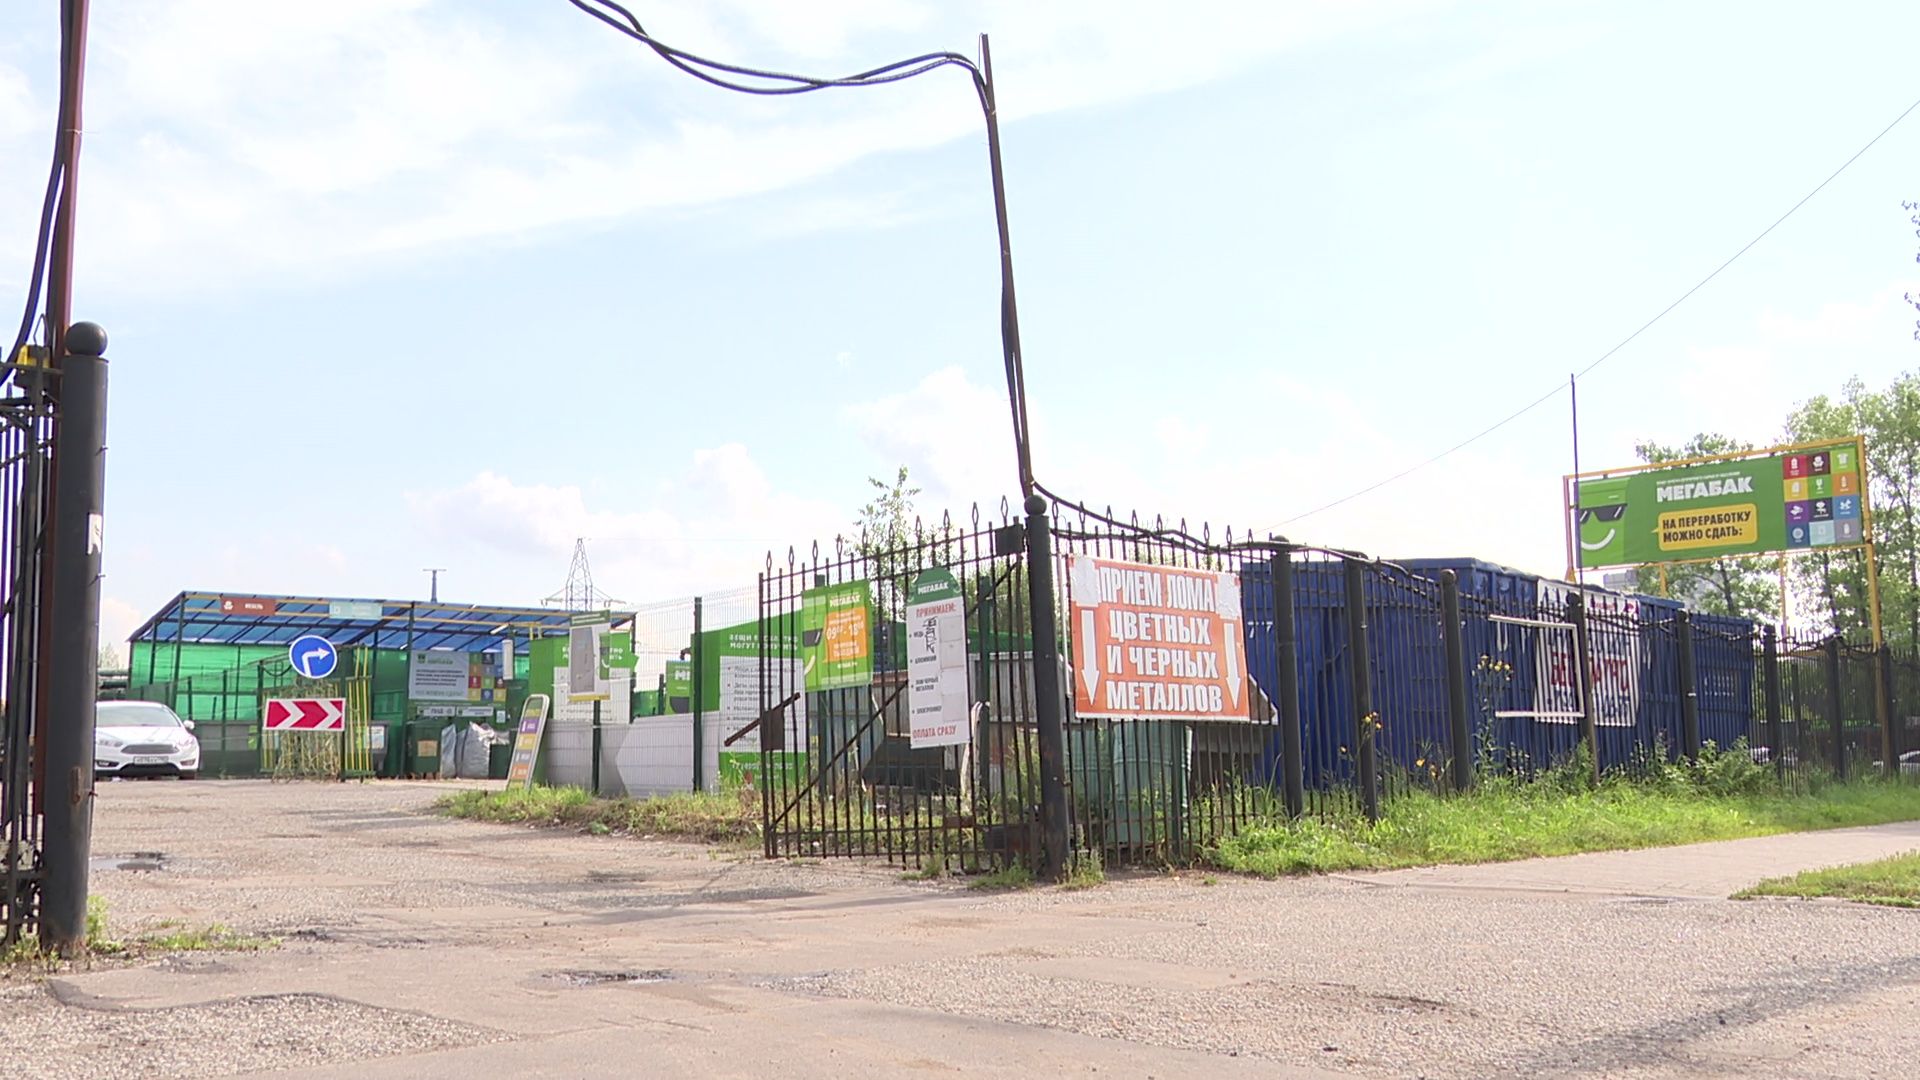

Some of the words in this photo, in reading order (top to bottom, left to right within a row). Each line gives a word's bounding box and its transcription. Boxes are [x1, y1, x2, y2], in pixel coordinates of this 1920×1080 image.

[1656, 476, 1753, 502] МЕГАБАК
[1662, 518, 1676, 529] НА
[1678, 511, 1752, 528] ПЕРЕРАБОТКУ
[1663, 529, 1703, 543] МОЖНО
[1705, 526, 1743, 540] СДАТЬ:
[917, 581, 949, 595] МЕГАБАК
[1099, 567, 1162, 607] ПРИЕМ
[1167, 574, 1216, 611] ЛОМА
[1109, 609, 1211, 645] ЦВЕТНЫХ
[1106, 644, 1123, 674] И
[1129, 647, 1219, 679] ЧЕРНЫХ
[1107, 681, 1222, 713] МЕТАЛЛОВ
[937, 725, 957, 736] СРАЗУ
